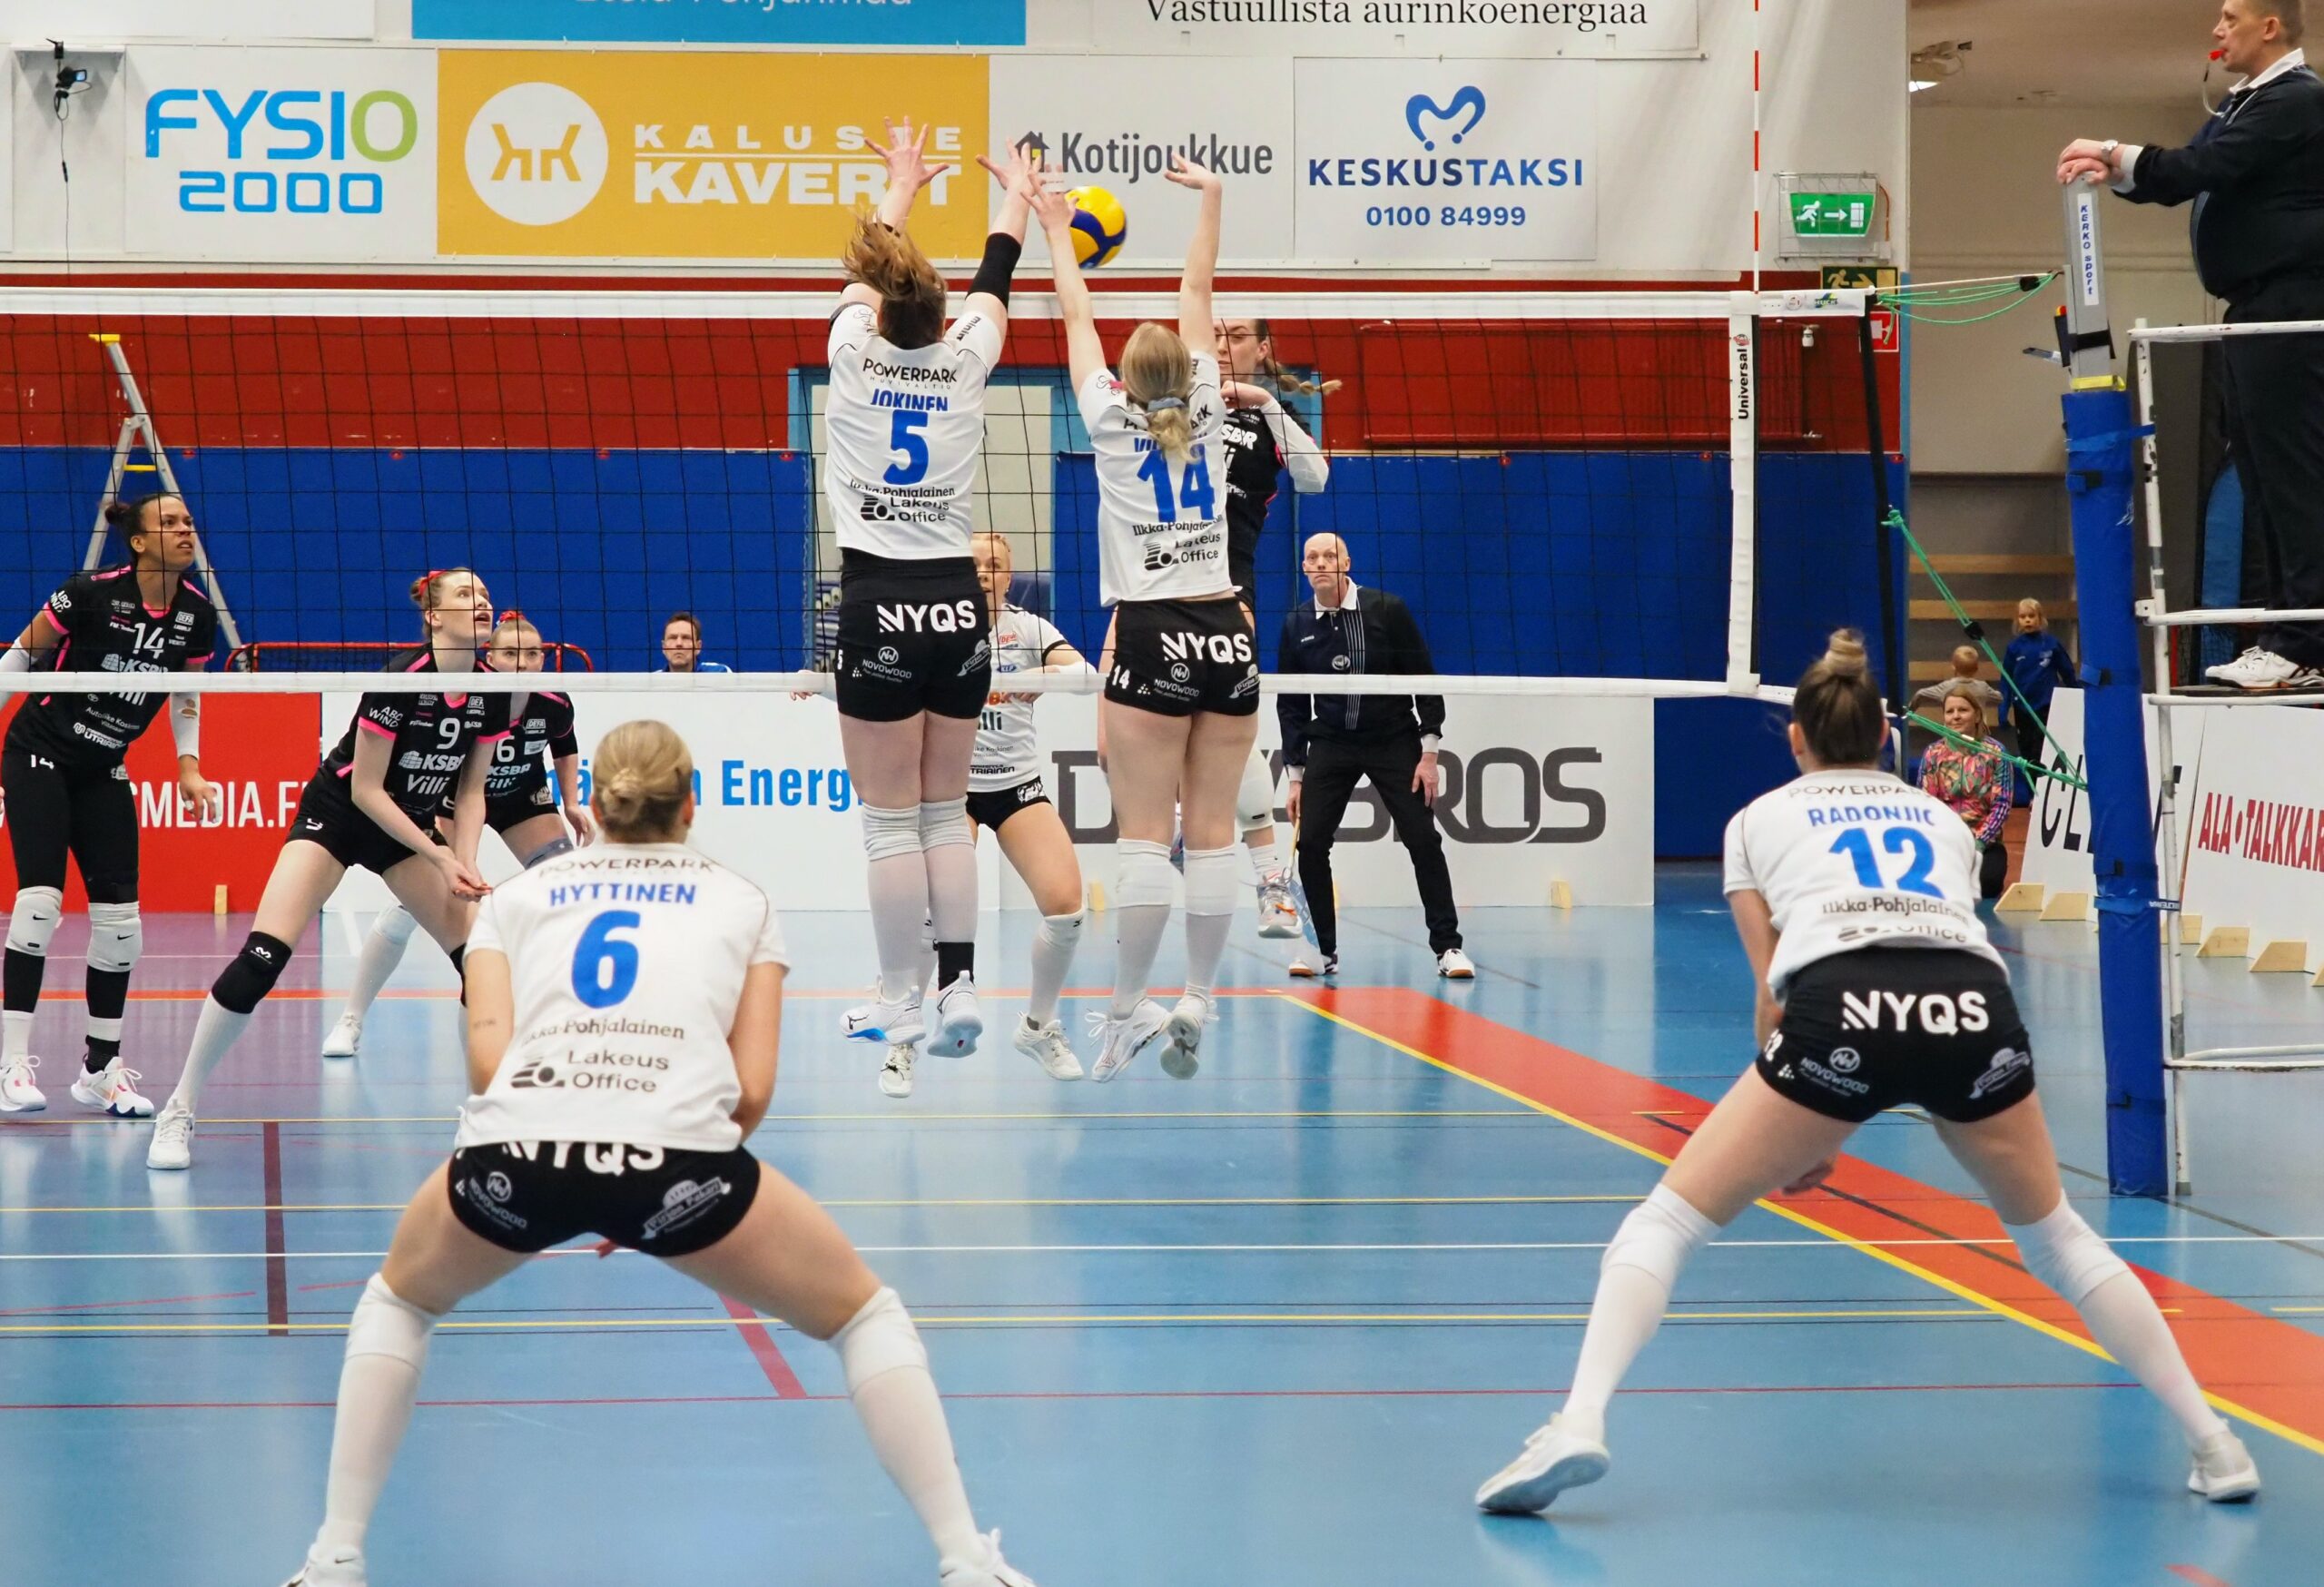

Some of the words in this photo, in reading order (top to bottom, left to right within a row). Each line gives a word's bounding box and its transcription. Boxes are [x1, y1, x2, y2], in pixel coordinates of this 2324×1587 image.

[1147, 0, 1352, 23] Vastuullista
[1364, 0, 1649, 32] aurinkoenergiaa
[145, 89, 418, 163] FYSIO
[1061, 132, 1273, 183] Kotijoukkue
[1309, 158, 1583, 186] KESKUSTAKSI
[179, 171, 383, 213] 2000
[635, 161, 961, 205] KAVERT
[1365, 205, 1431, 226] 0100
[1440, 206, 1526, 226] 84999
[2081, 204, 2092, 250] KERKO
[862, 358, 958, 383] POWERPARK
[1738, 348, 1749, 419] Universal
[882, 409, 929, 486] 5
[1221, 424, 1258, 450] SBR
[1137, 442, 1215, 523] 14
[898, 511, 946, 523] Office
[1181, 549, 1219, 563] Office
[876, 600, 977, 633] NYQS
[133, 623, 164, 659] 14
[1160, 632, 1252, 665] NYQS
[1112, 665, 1131, 689] 14
[437, 717, 460, 749] 9
[497, 734, 516, 763] 6
[407, 774, 450, 795] Villi
[722, 760, 862, 812] Energ
[130, 781, 308, 828] MEDIA.F
[1828, 826, 1945, 899] 12
[550, 883, 696, 906] HYTTINEN
[571, 910, 641, 1009] 6
[1842, 991, 1990, 1035] NYQS
[567, 1050, 669, 1070] Lakeus
[573, 1071, 656, 1092] Office
